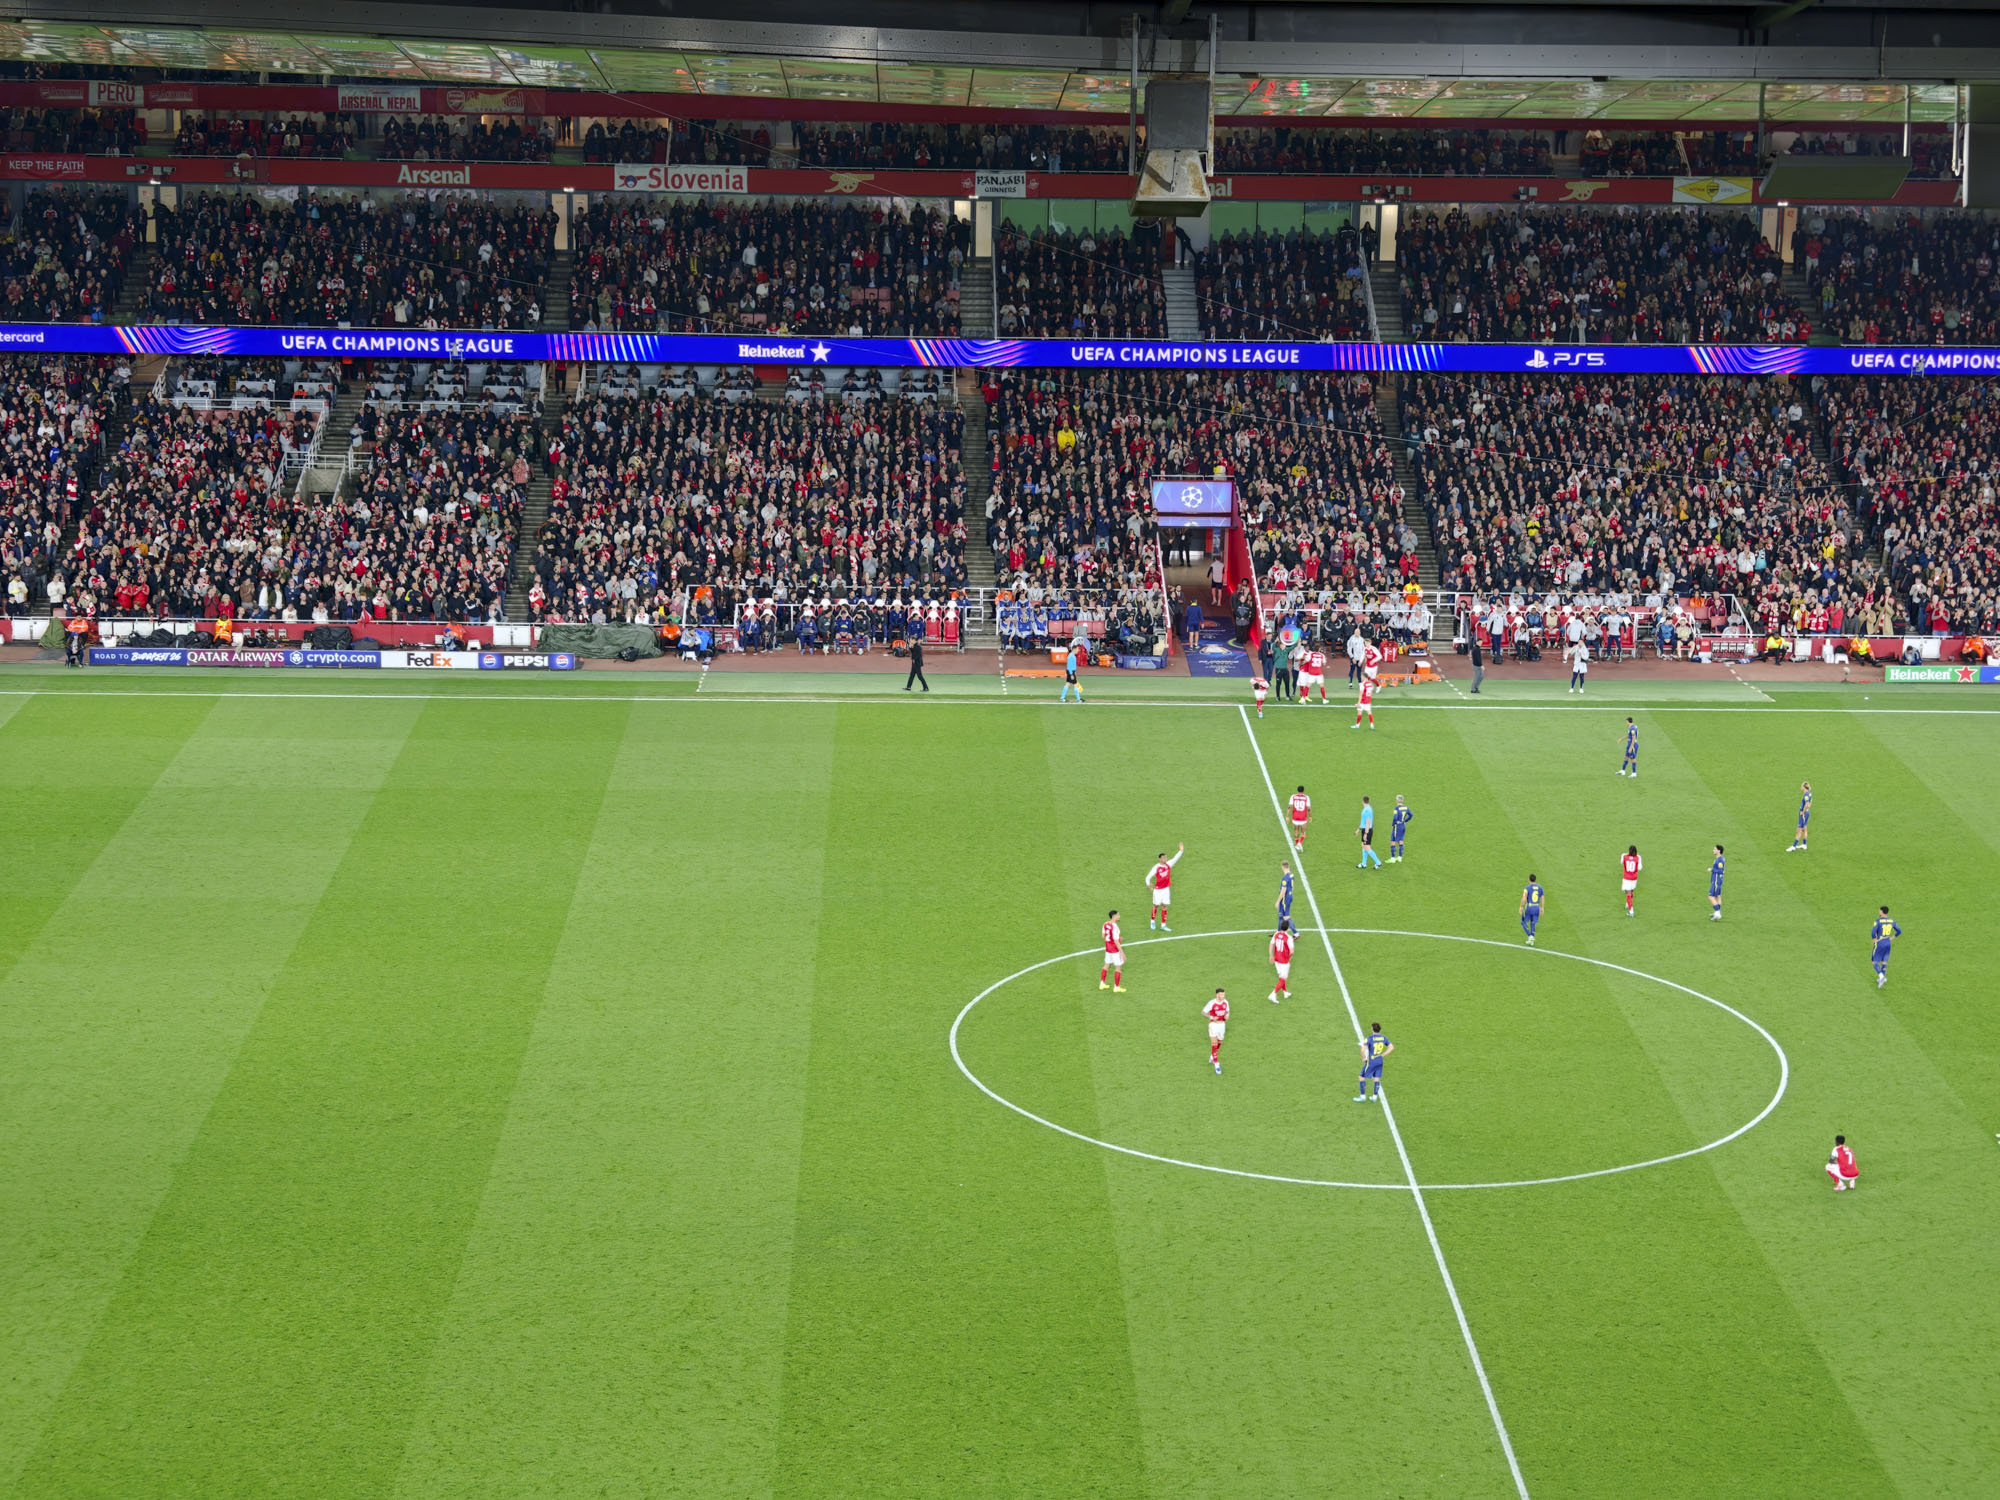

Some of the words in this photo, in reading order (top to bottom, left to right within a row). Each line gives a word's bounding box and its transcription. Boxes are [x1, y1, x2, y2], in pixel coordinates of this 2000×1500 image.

[97, 83, 136, 102] PERU
[341, 95, 384, 109] ARSENAL
[387, 96, 419, 110] NEPAL
[9, 160, 33, 170] KEEP
[36, 161, 54, 170] THE
[56, 161, 84, 171] FAITH
[397, 164, 470, 185] Arsenal
[648, 167, 744, 190] Slovenia
[976, 175, 1025, 185] PANJABI
[281, 335, 327, 350] UEFA
[332, 336, 440, 352] CHAMPIONS
[445, 338, 514, 353] LEAGUE
[738, 344, 806, 359] Heineken
[1071, 346, 1116, 361] UEFA
[1120, 347, 1228, 363] CHAMPIONS
[1232, 348, 1300, 364] LEAGUE
[1553, 352, 1605, 366] PS5
[1851, 353, 1896, 368] UEFA
[187, 651, 229, 663] QATAR
[232, 652, 285, 662] AIRWAYS
[306, 652, 377, 664] crypto.com
[406, 652, 453, 667] FedEx
[503, 655, 549, 667] PEPSI
[1890, 668, 1952, 681] Heineken
[1626, 860, 1636, 872] 10
[1532, 890, 1539, 903] 6
[1373, 1042, 1384, 1055] 19
[1845, 1151, 1853, 1165] 7
